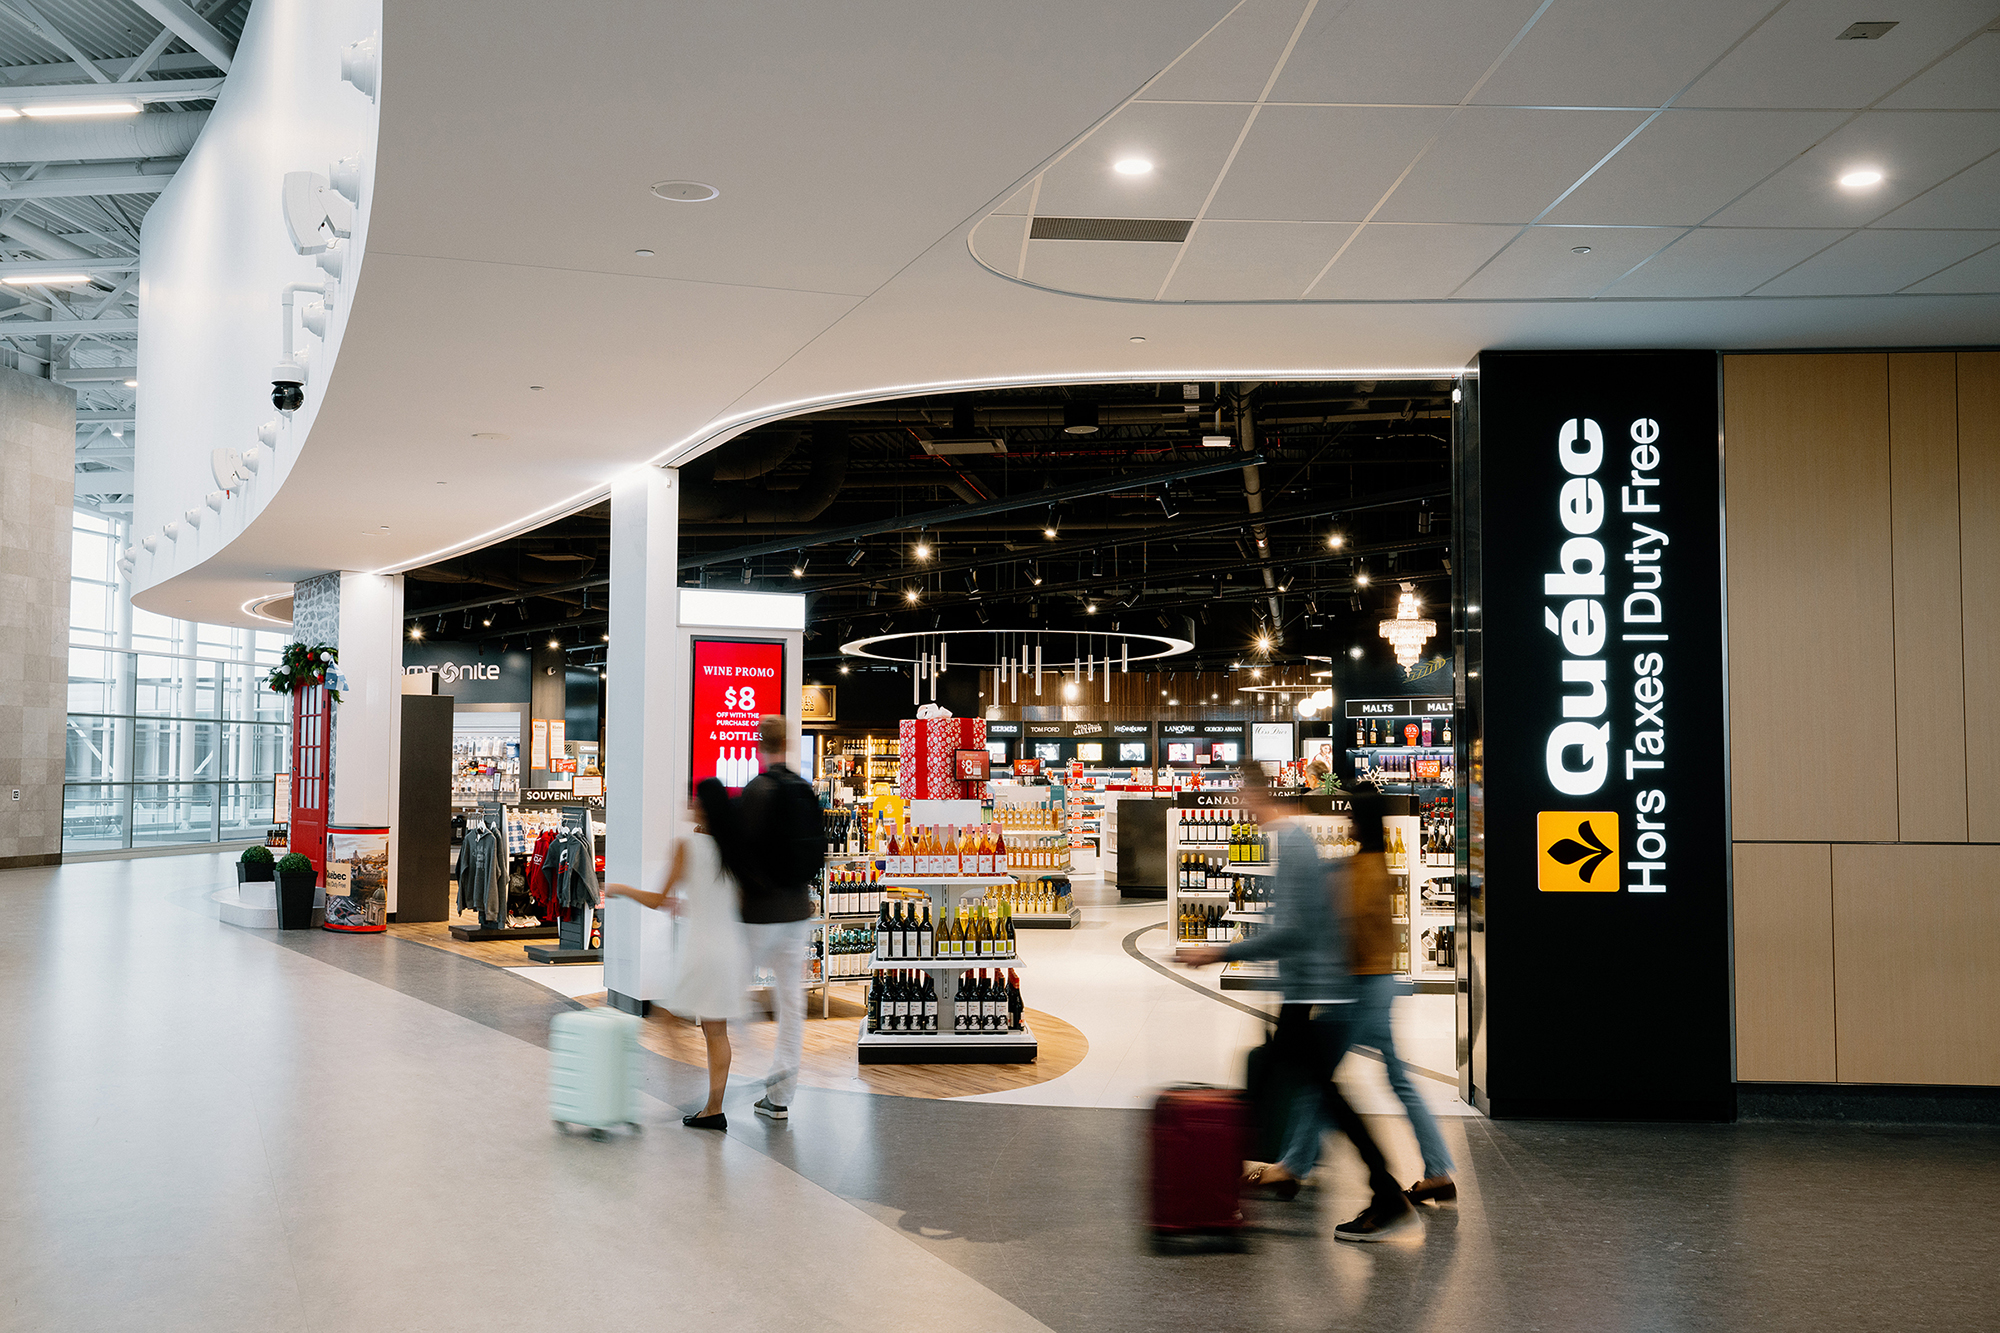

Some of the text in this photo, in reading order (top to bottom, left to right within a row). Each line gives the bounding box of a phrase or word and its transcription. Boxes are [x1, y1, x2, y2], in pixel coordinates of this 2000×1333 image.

[1621, 417, 1661, 514] Free
[1622, 521, 1670, 624] Duty
[1544, 417, 1610, 796] Québec
[703, 665, 775, 678] WINE PROMO
[724, 686, 756, 711] $8
[1362, 704, 1394, 713] MALTS
[1427, 702, 1454, 712] MALT
[1626, 651, 1666, 781] Taxes
[716, 719, 750, 727] PURCHASE
[709, 730, 763, 742] 4 BOTTLES
[1254, 725, 1288, 735] Miss Dior
[961, 759, 973, 775] $8
[1018, 764, 1027, 773] $8
[1332, 800, 1353, 811] ITA
[1627, 789, 1668, 893] Hors
